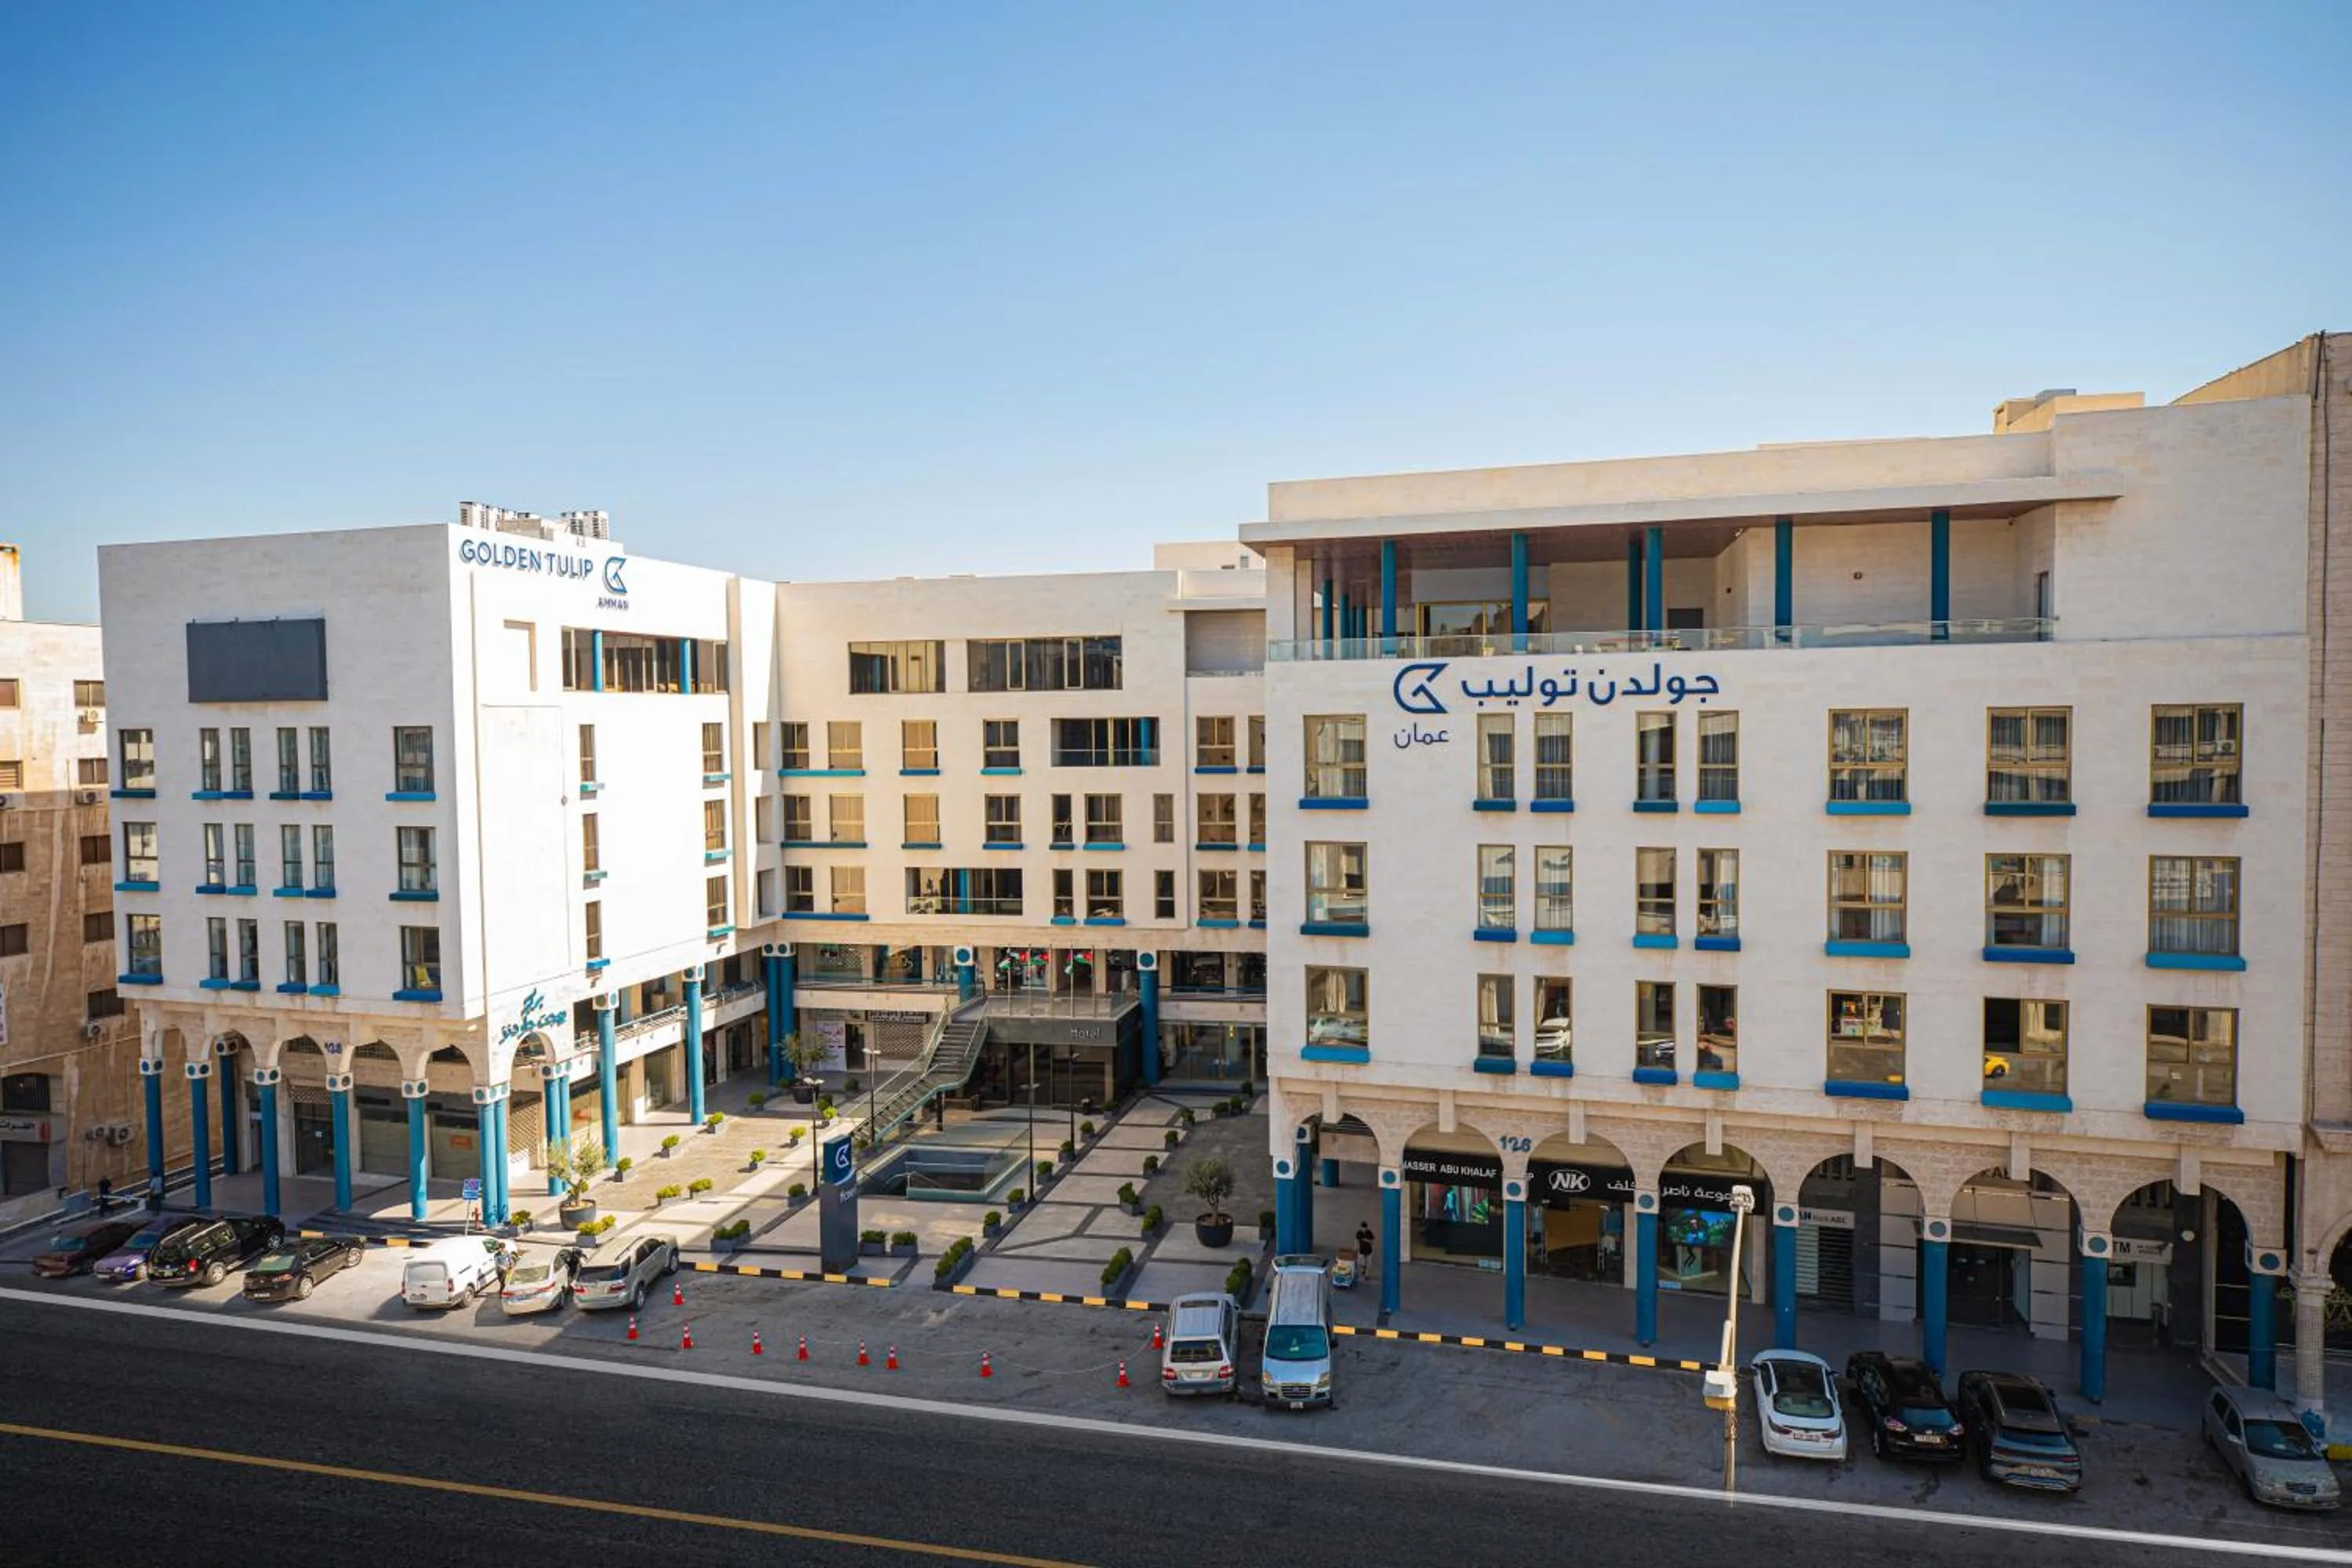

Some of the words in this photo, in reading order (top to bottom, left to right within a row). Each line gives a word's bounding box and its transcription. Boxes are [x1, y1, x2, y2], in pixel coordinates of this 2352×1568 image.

[459, 539, 542, 572] GOLDEN
[546, 552, 594, 579] TULIP
[1461, 666, 1578, 706] توليب
[1588, 663, 1719, 705] جولدن
[1394, 722, 1450, 749] عمان
[1440, 1163, 1459, 1174] ABU
[1461, 1166, 1497, 1178] KHALAF
[1552, 1172, 1587, 1190] NK
[2113, 1241, 2131, 1254] TM
